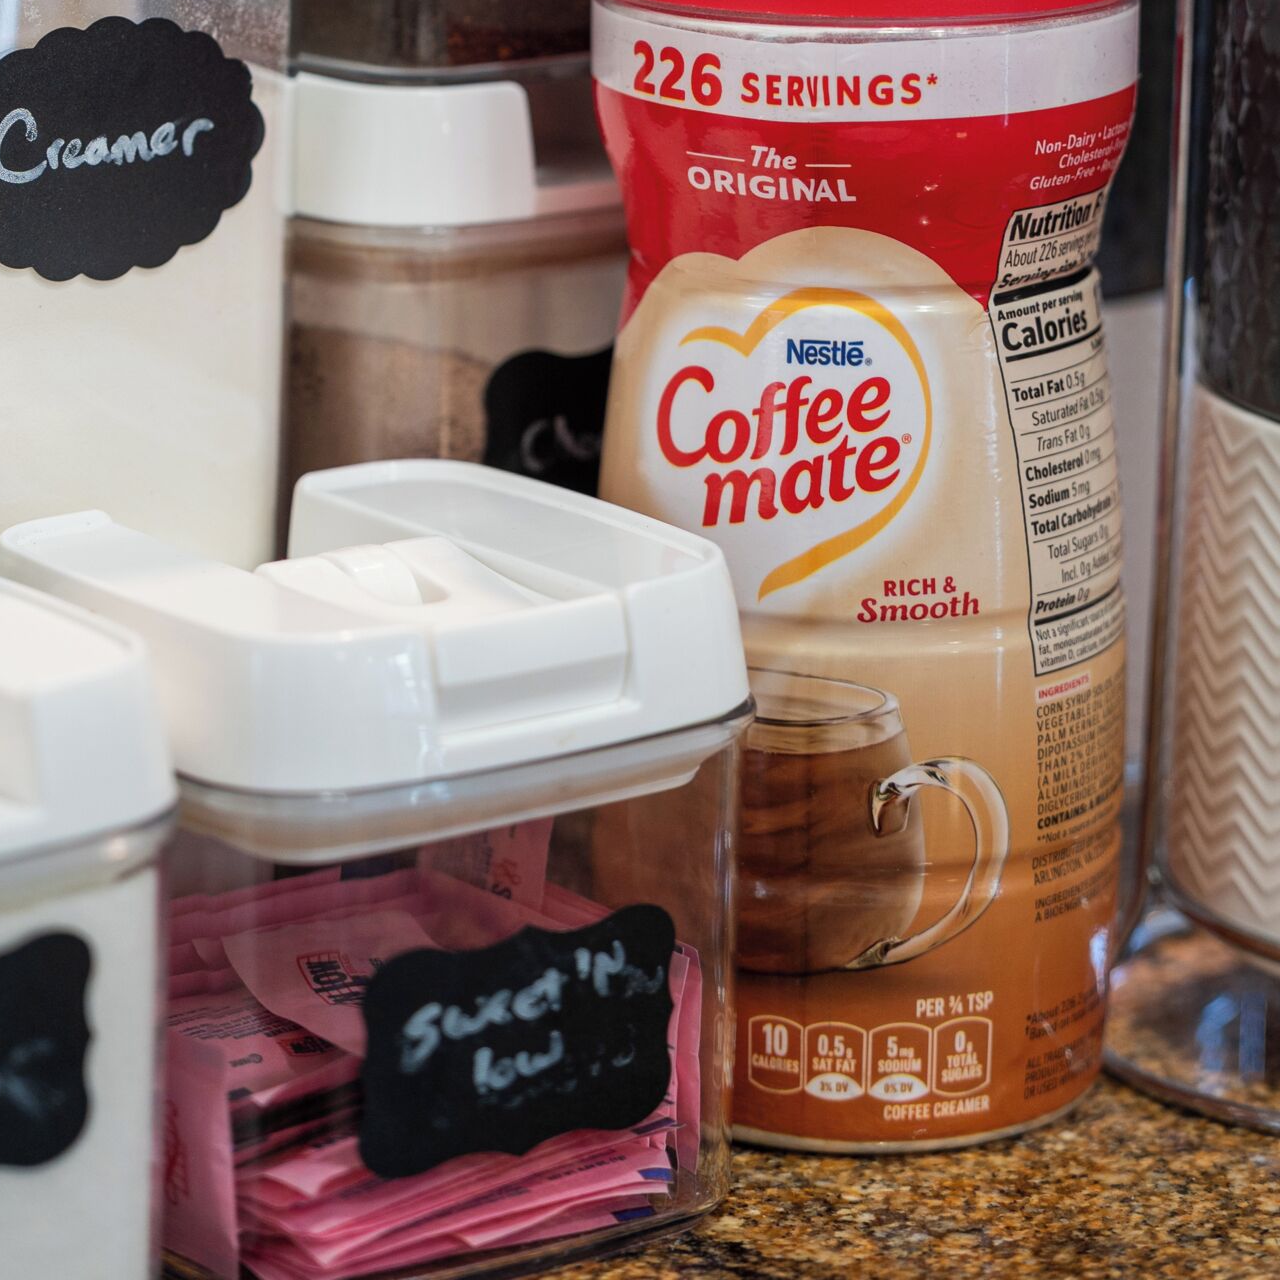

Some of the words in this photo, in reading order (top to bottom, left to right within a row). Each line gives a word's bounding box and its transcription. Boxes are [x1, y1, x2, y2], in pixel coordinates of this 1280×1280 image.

[632, 39, 724, 107] 226
[1034, 131, 1097, 156] Non-Dairy
[750, 144, 798, 171] The
[687, 165, 857, 203] ORIGINAL
[1029, 165, 1096, 191] Gluten-Free
[1008, 200, 1092, 242] Nutrition
[1004, 246, 1038, 268] About
[1038, 240, 1058, 262] 226
[997, 303, 1040, 322] Amount
[1042, 300, 1057, 314] per
[1058, 290, 1083, 307] serving
[1001, 308, 1088, 352] Calories
[786, 338, 864, 367] Nestlé
[1012, 382, 1045, 403] Total
[1046, 378, 1065, 395] Fat
[656, 365, 891, 468] Coffee
[1031, 400, 1079, 427] Saturated
[1036, 434, 1064, 452] Trans
[1064, 428, 1078, 444] Fat
[1025, 451, 1084, 482] Cholesterol
[701, 435, 901, 527] mate
[1028, 486, 1070, 509] Sodium
[1031, 515, 1060, 536] Total
[1047, 537, 1071, 560] Total
[1071, 530, 1099, 552] Sugars
[883, 578, 936, 597] RICH
[943, 576, 957, 595] &
[856, 591, 980, 623] Smooth
[1035, 592, 1076, 614] Protein
[1035, 628, 1051, 641] Not
[1038, 673, 1090, 699] INGREDIENTS
[1036, 701, 1063, 719] CORN
[1065, 689, 1092, 710] SYRUP
[1036, 704, 1091, 733] VEGETABLE
[1037, 727, 1067, 747] PALM
[1038, 756, 1068, 774] THAN
[1052, 765, 1077, 783] MILK
[915, 997, 945, 1018] PER
[966, 991, 994, 1013] TSP
[762, 1022, 789, 1057] 10
[751, 1053, 800, 1074] CALORIES
[811, 1057, 834, 1072] SAT
[835, 1057, 857, 1074] FAT
[877, 1058, 922, 1073] SODIUM
[946, 1052, 979, 1069] TOTAL
[941, 1064, 983, 1084] SUGARS
[835, 1081, 849, 1094] DV
[900, 1081, 914, 1094] DV
[883, 1102, 930, 1120] COFFEE
[933, 1094, 991, 1118] CREAMER
